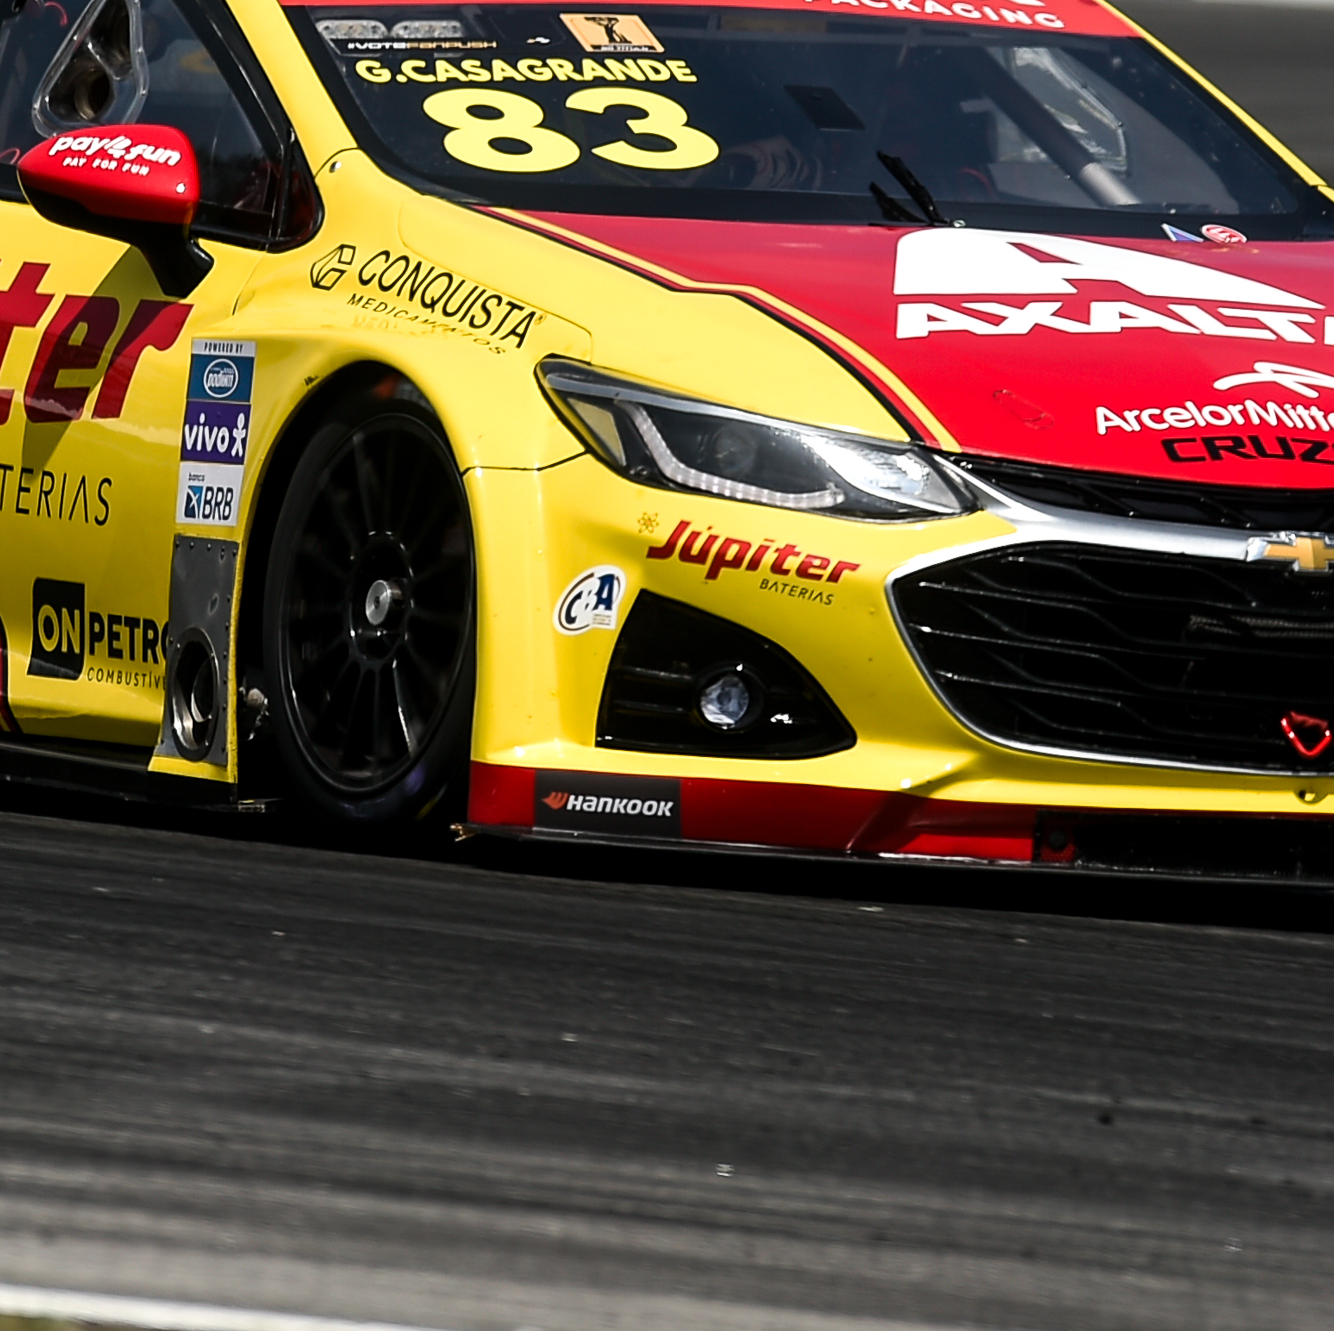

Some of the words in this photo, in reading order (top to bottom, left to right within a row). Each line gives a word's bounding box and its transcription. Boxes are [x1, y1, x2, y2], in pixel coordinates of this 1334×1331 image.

[355, 58, 698, 84] G.CASAGRANDE
[423, 87, 721, 173] 83
[63, 156, 88, 168] PAY
[92, 158, 118, 171] FOR
[122, 162, 150, 177] FUN
[357, 249, 537, 350] CONQUISTA
[203, 341, 233, 354] POWERED
[184, 412, 230, 453] vivo
[201, 485, 234, 521] BRB
[646, 519, 862, 584] Júpiter
[759, 578, 835, 607] BATERIAS
